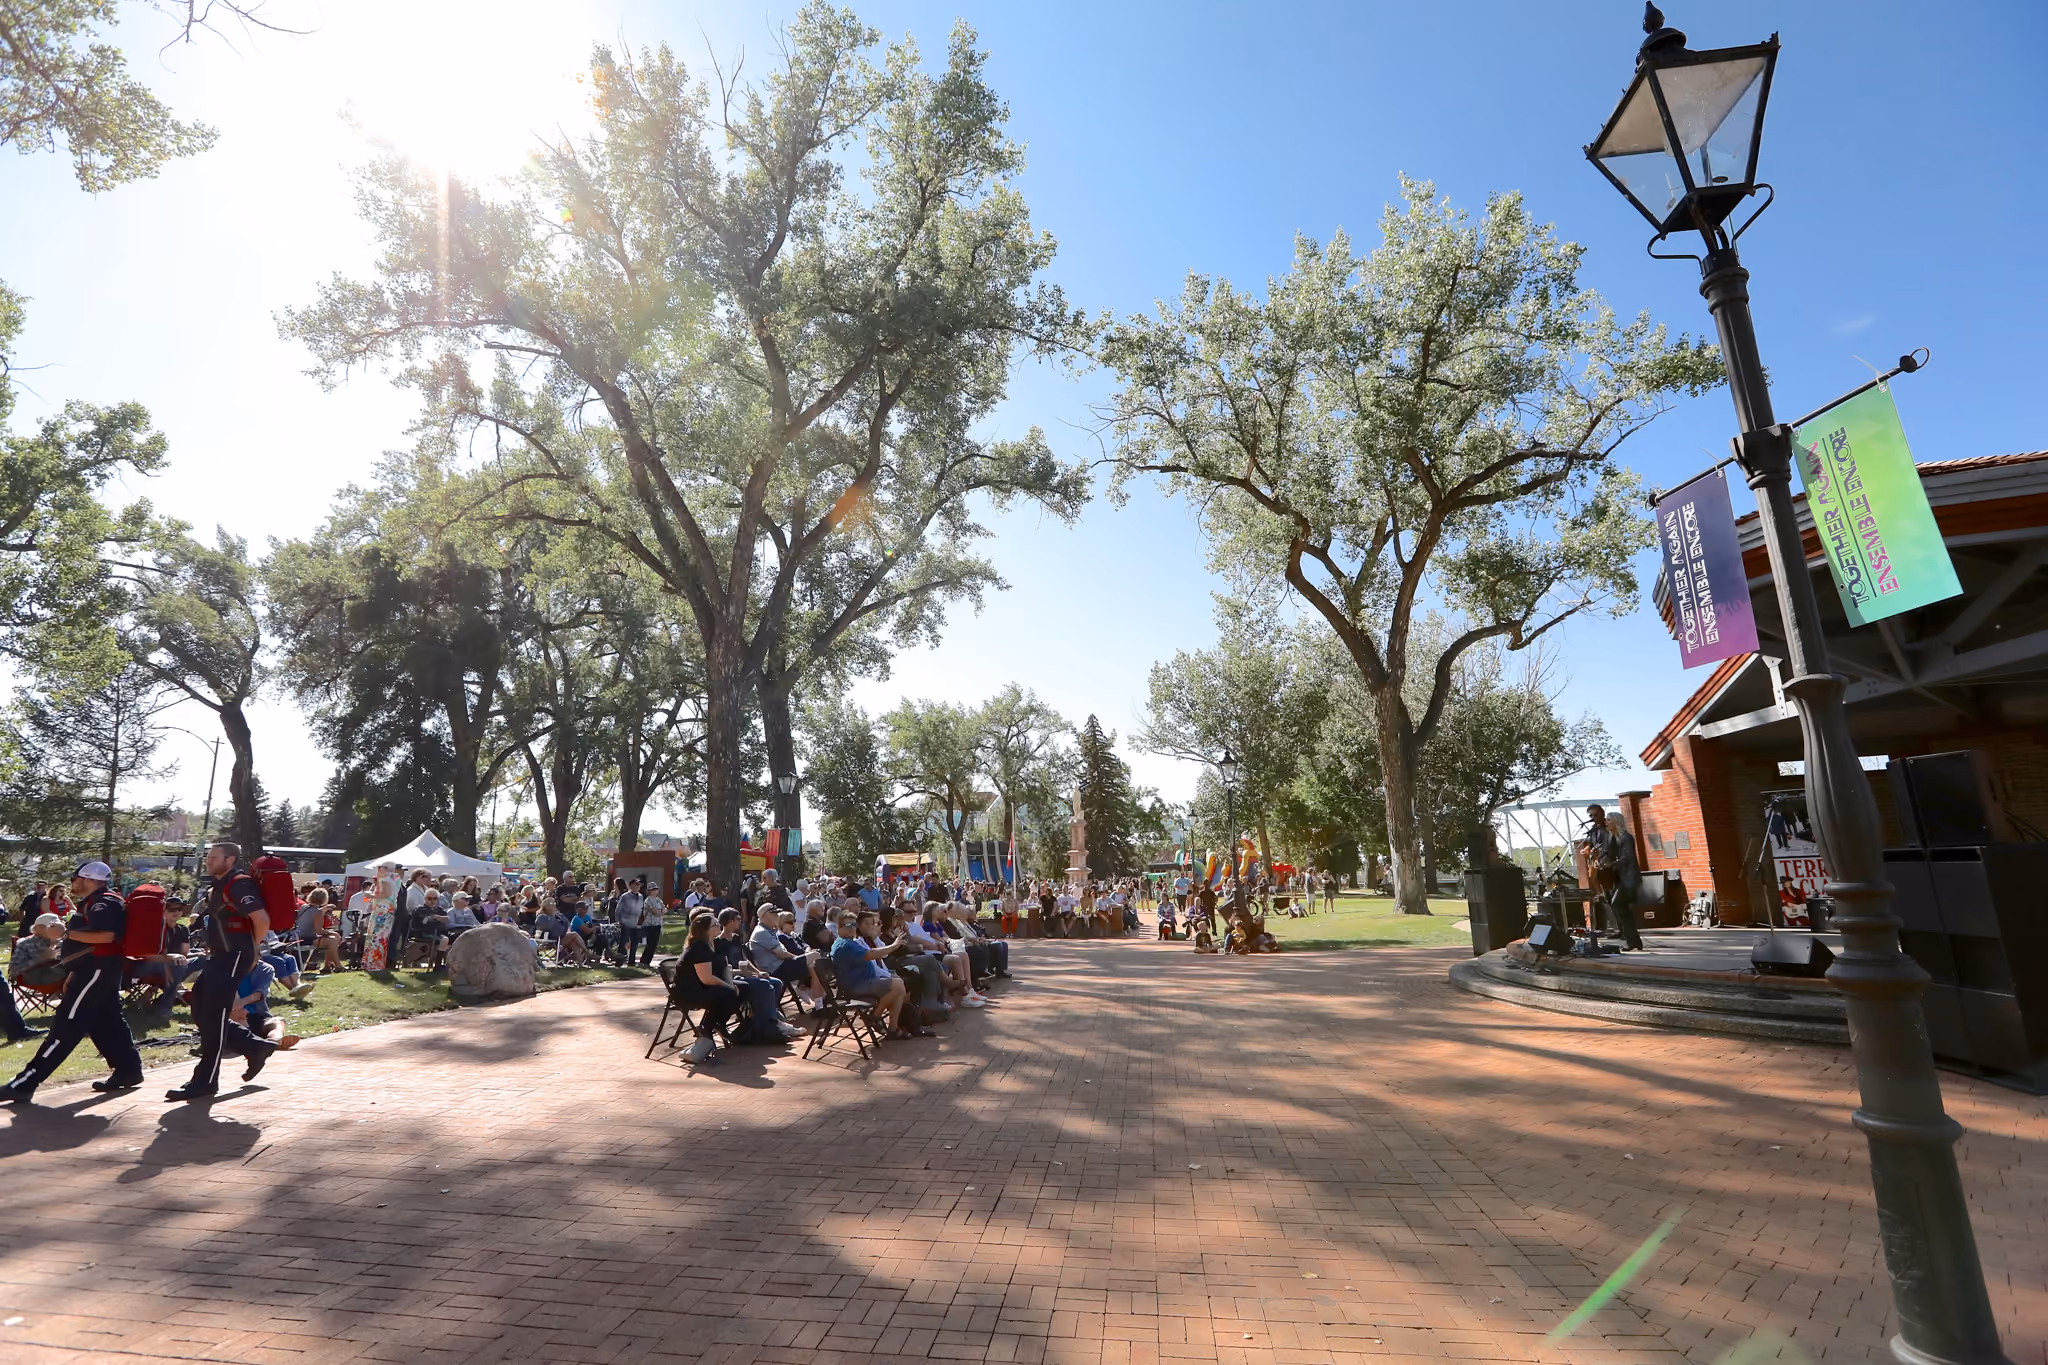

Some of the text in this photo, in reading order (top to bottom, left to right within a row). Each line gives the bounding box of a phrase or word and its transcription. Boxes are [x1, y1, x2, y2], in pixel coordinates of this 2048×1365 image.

[1664, 511, 1699, 653] TOGETHER AGAIN
[1682, 502, 1719, 644] ENSEMBLE ENCORE
[1805, 441, 1869, 608] TOGETHER AGAIN
[1829, 427, 1899, 595] ENSEMBLE ENCORE
